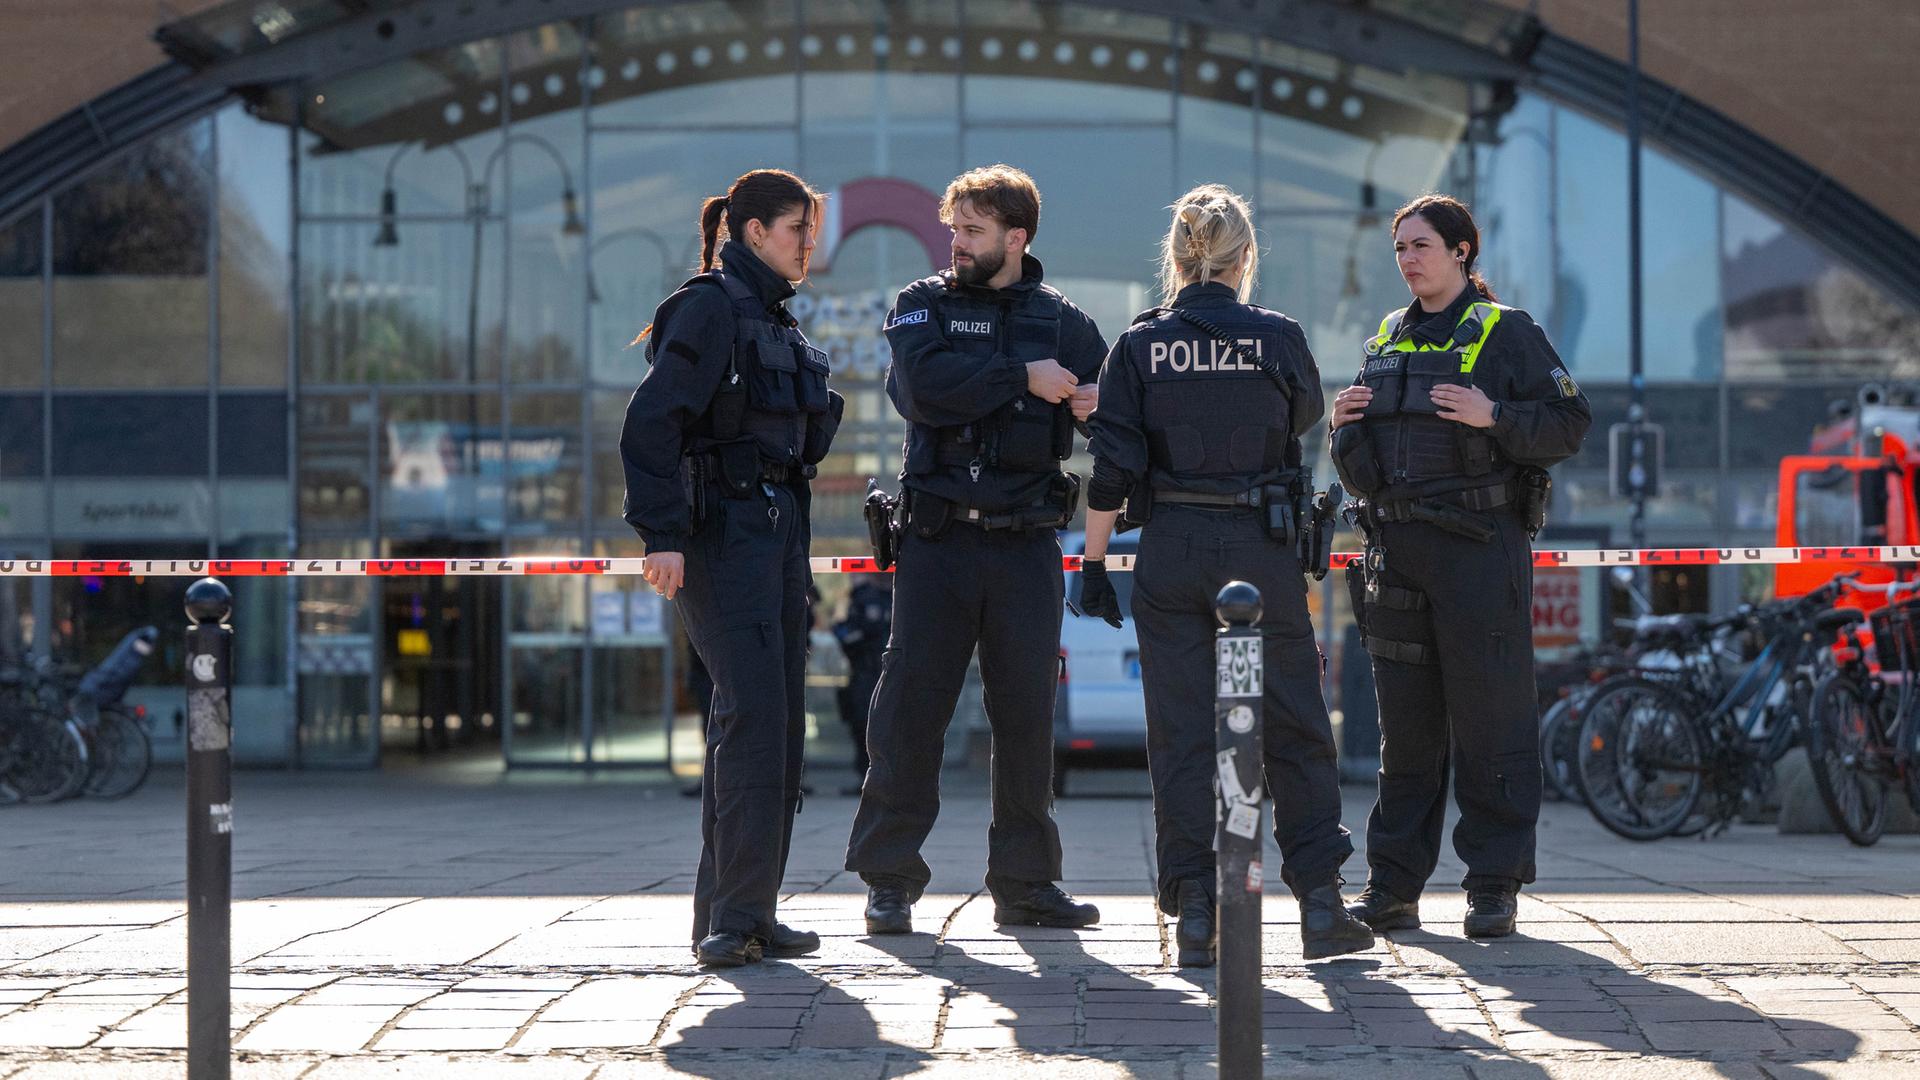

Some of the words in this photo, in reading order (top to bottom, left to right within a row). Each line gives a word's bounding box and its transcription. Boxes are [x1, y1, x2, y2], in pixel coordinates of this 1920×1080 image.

[950, 320, 991, 334] POLIZEI
[1150, 338, 1262, 374] POLIZEI
[1366, 356, 1400, 372] POLIZEI
